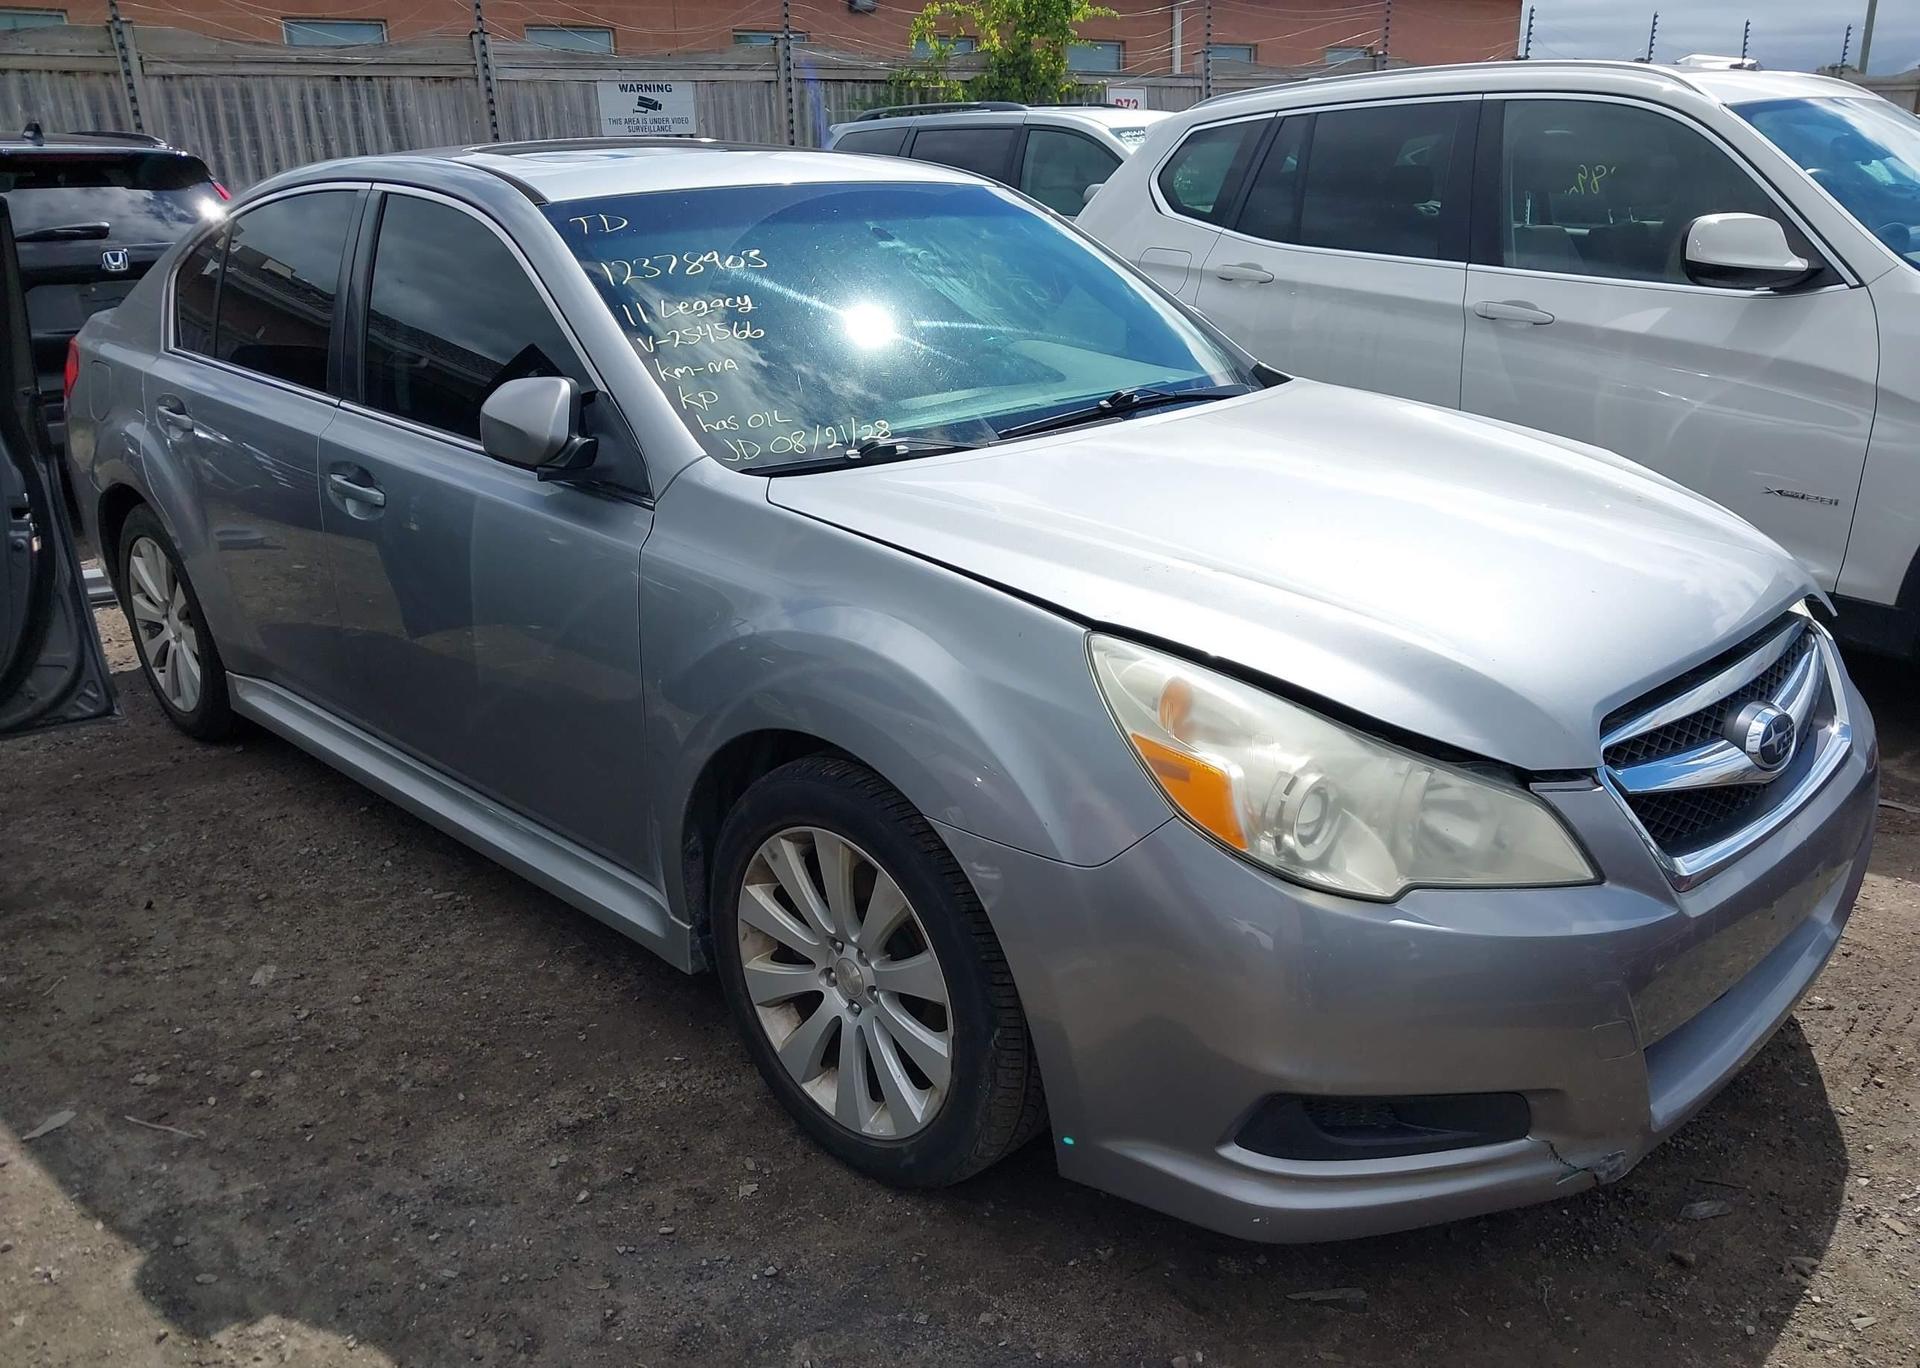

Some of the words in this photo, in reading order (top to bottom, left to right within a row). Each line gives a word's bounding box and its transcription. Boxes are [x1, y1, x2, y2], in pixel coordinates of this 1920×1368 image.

[618, 83, 673, 93] WARNING
[608, 118, 622, 126] THIS
[624, 117, 640, 125] AREA
[641, 117, 648, 125] IS
[649, 117, 670, 125] UNDER
[671, 116, 689, 125] VIDEO
[627, 124, 672, 133] SURVEILLANCE
[600, 248, 768, 287] 12378903
[622, 302, 650, 327] 11
[661, 294, 758, 319] Legacy
[696, 414, 740, 433] has
[721, 438, 761, 462] JD
